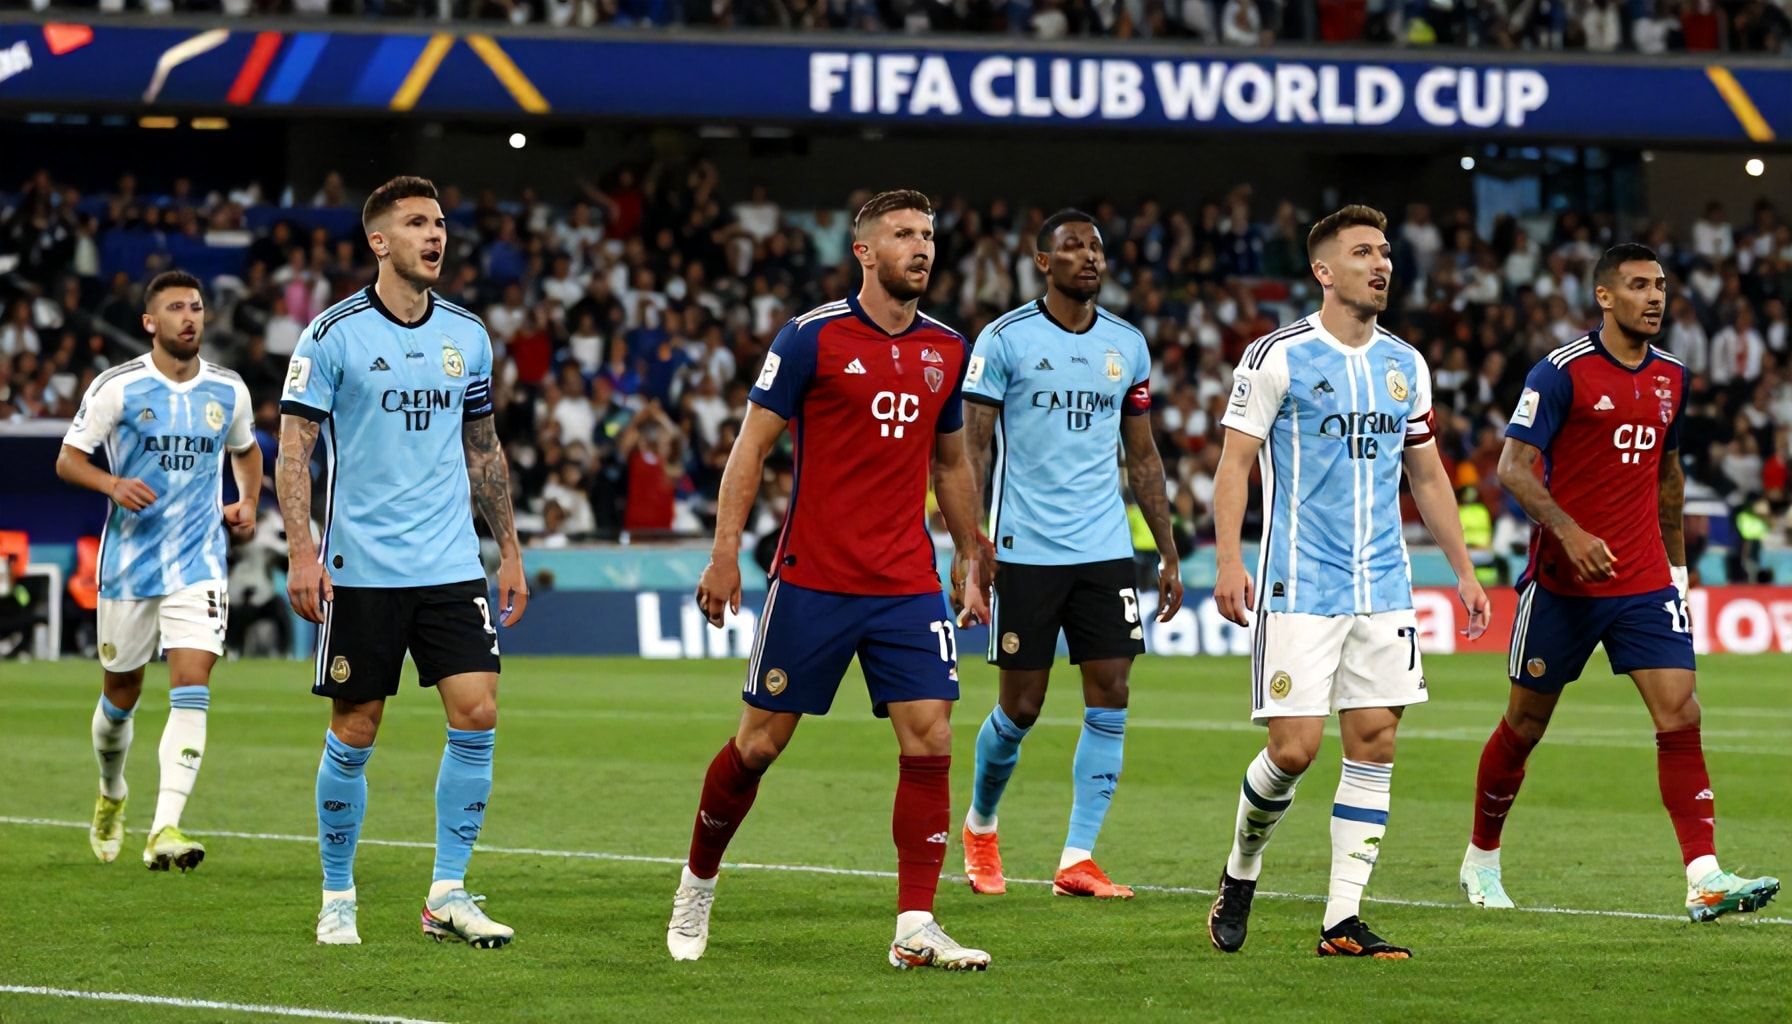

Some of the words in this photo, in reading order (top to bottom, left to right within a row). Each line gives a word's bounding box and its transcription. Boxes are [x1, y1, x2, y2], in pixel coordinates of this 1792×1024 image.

[809, 53, 962, 115] FIFA
[969, 56, 1146, 119] CLUB
[1152, 61, 1405, 125] WORLD
[1415, 67, 1549, 127] CUP
